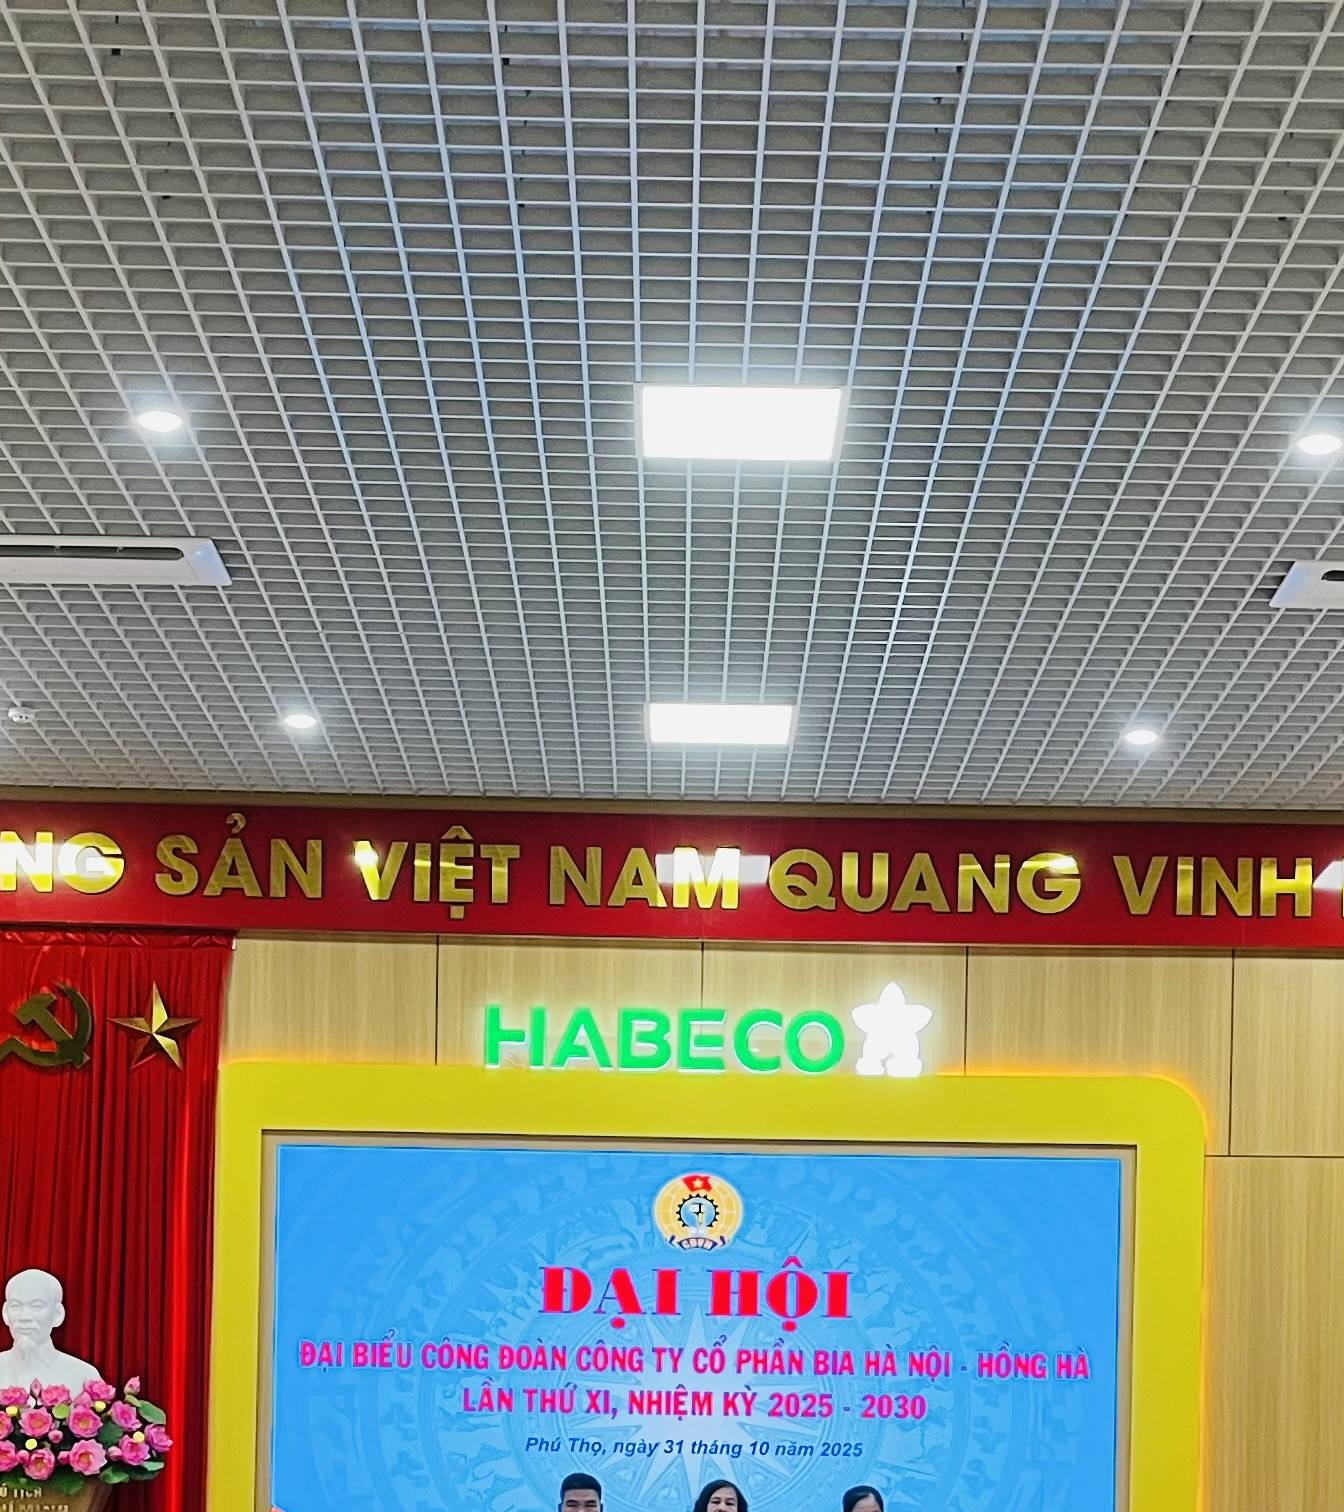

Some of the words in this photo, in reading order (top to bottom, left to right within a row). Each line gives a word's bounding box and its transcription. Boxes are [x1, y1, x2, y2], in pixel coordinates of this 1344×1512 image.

[155, 812, 324, 898] SẢN
[354, 825, 521, 919] VIỆT
[550, 846, 741, 910] NAM
[768, 848, 1082, 914] QUANG
[1112, 855, 1313, 917] VINH
[484, 1004, 845, 1074] HABECO
[538, 1266, 682, 1329] ĐẠI
[706, 1256, 853, 1332] HỘI
[299, 1341, 344, 1373] ĐẠI
[352, 1328, 413, 1369] BIỂU
[421, 1337, 489, 1370] CÔNG
[498, 1338, 567, 1371] ĐOÀN
[576, 1339, 644, 1373] CÔNG
[651, 1347, 683, 1373] TY
[692, 1334, 727, 1374] CỔ
[736, 1337, 804, 1376] PHẦN
[813, 1349, 855, 1376] BIA
[864, 1344, 897, 1377] HÀ
[909, 1344, 951, 1382] NỘI
[977, 1341, 1047, 1379] HỒNG
[1056, 1347, 1090, 1380] HÀ
[463, 1377, 514, 1413] LẦN
[523, 1382, 578, 1414] THỨ
[584, 1389, 618, 1420] XI,
[628, 1384, 713, 1421] NHIỆM
[723, 1384, 758, 1417] KỲ
[767, 1392, 833, 1418] 2025
[860, 1394, 927, 1419] 2030
[525, 1437, 561, 1453] Phú
[569, 1438, 607, 1456] Thọ,
[613, 1438, 658, 1456] ngày
[663, 1440, 684, 1454] 31
[691, 1440, 743, 1458] tháng
[749, 1441, 769, 1456] 10
[774, 1441, 814, 1457] năm
[820, 1442, 863, 1458] 2025
